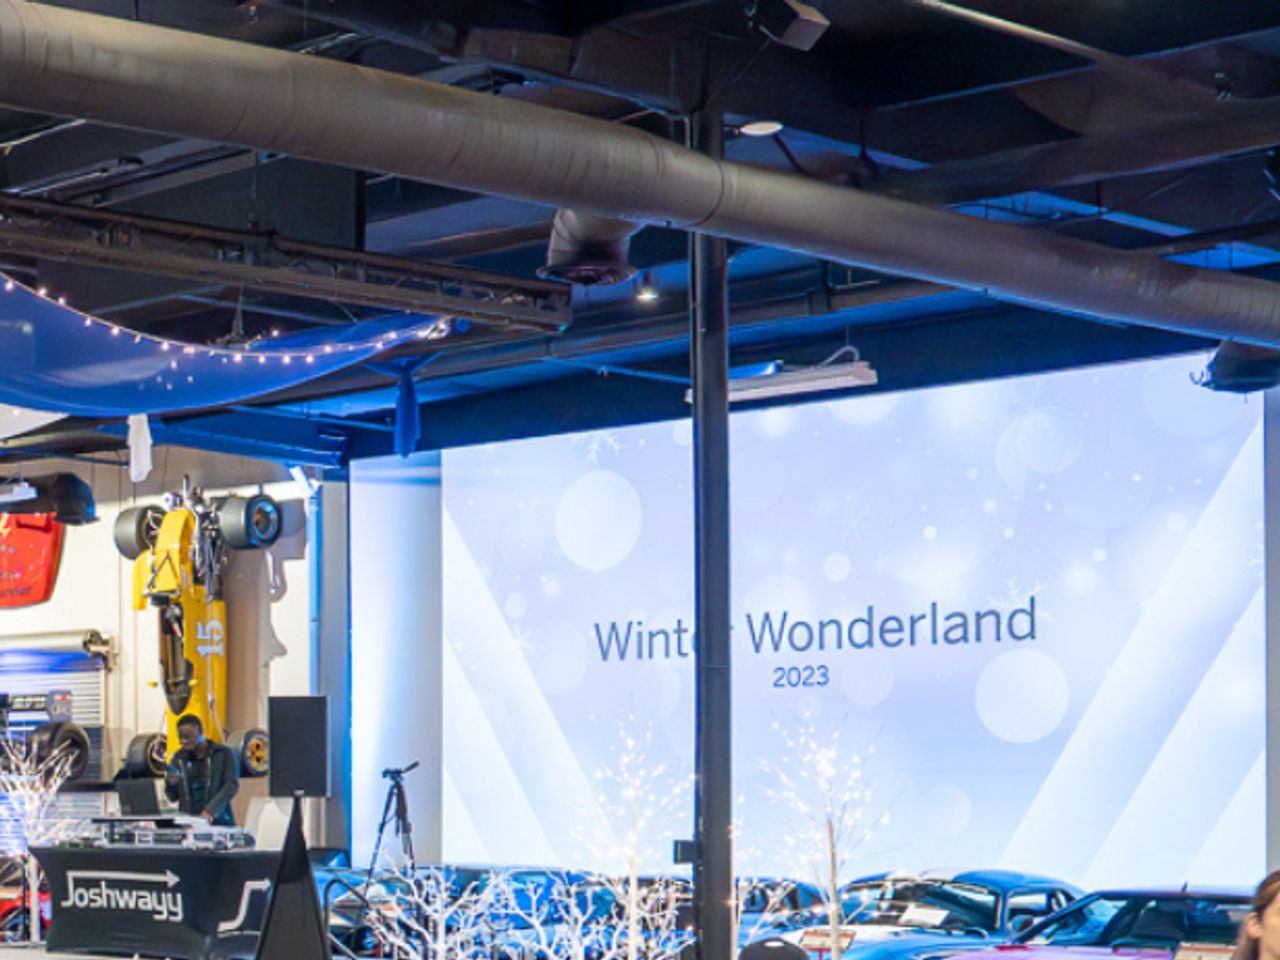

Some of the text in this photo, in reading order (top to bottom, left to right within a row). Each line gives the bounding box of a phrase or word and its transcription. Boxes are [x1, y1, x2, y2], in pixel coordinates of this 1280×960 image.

[197, 620, 224, 657] 15
[594, 596, 1037, 661] Wint Wonderland
[772, 665, 830, 688] 2023
[61, 870, 183, 922] Joshwayy
